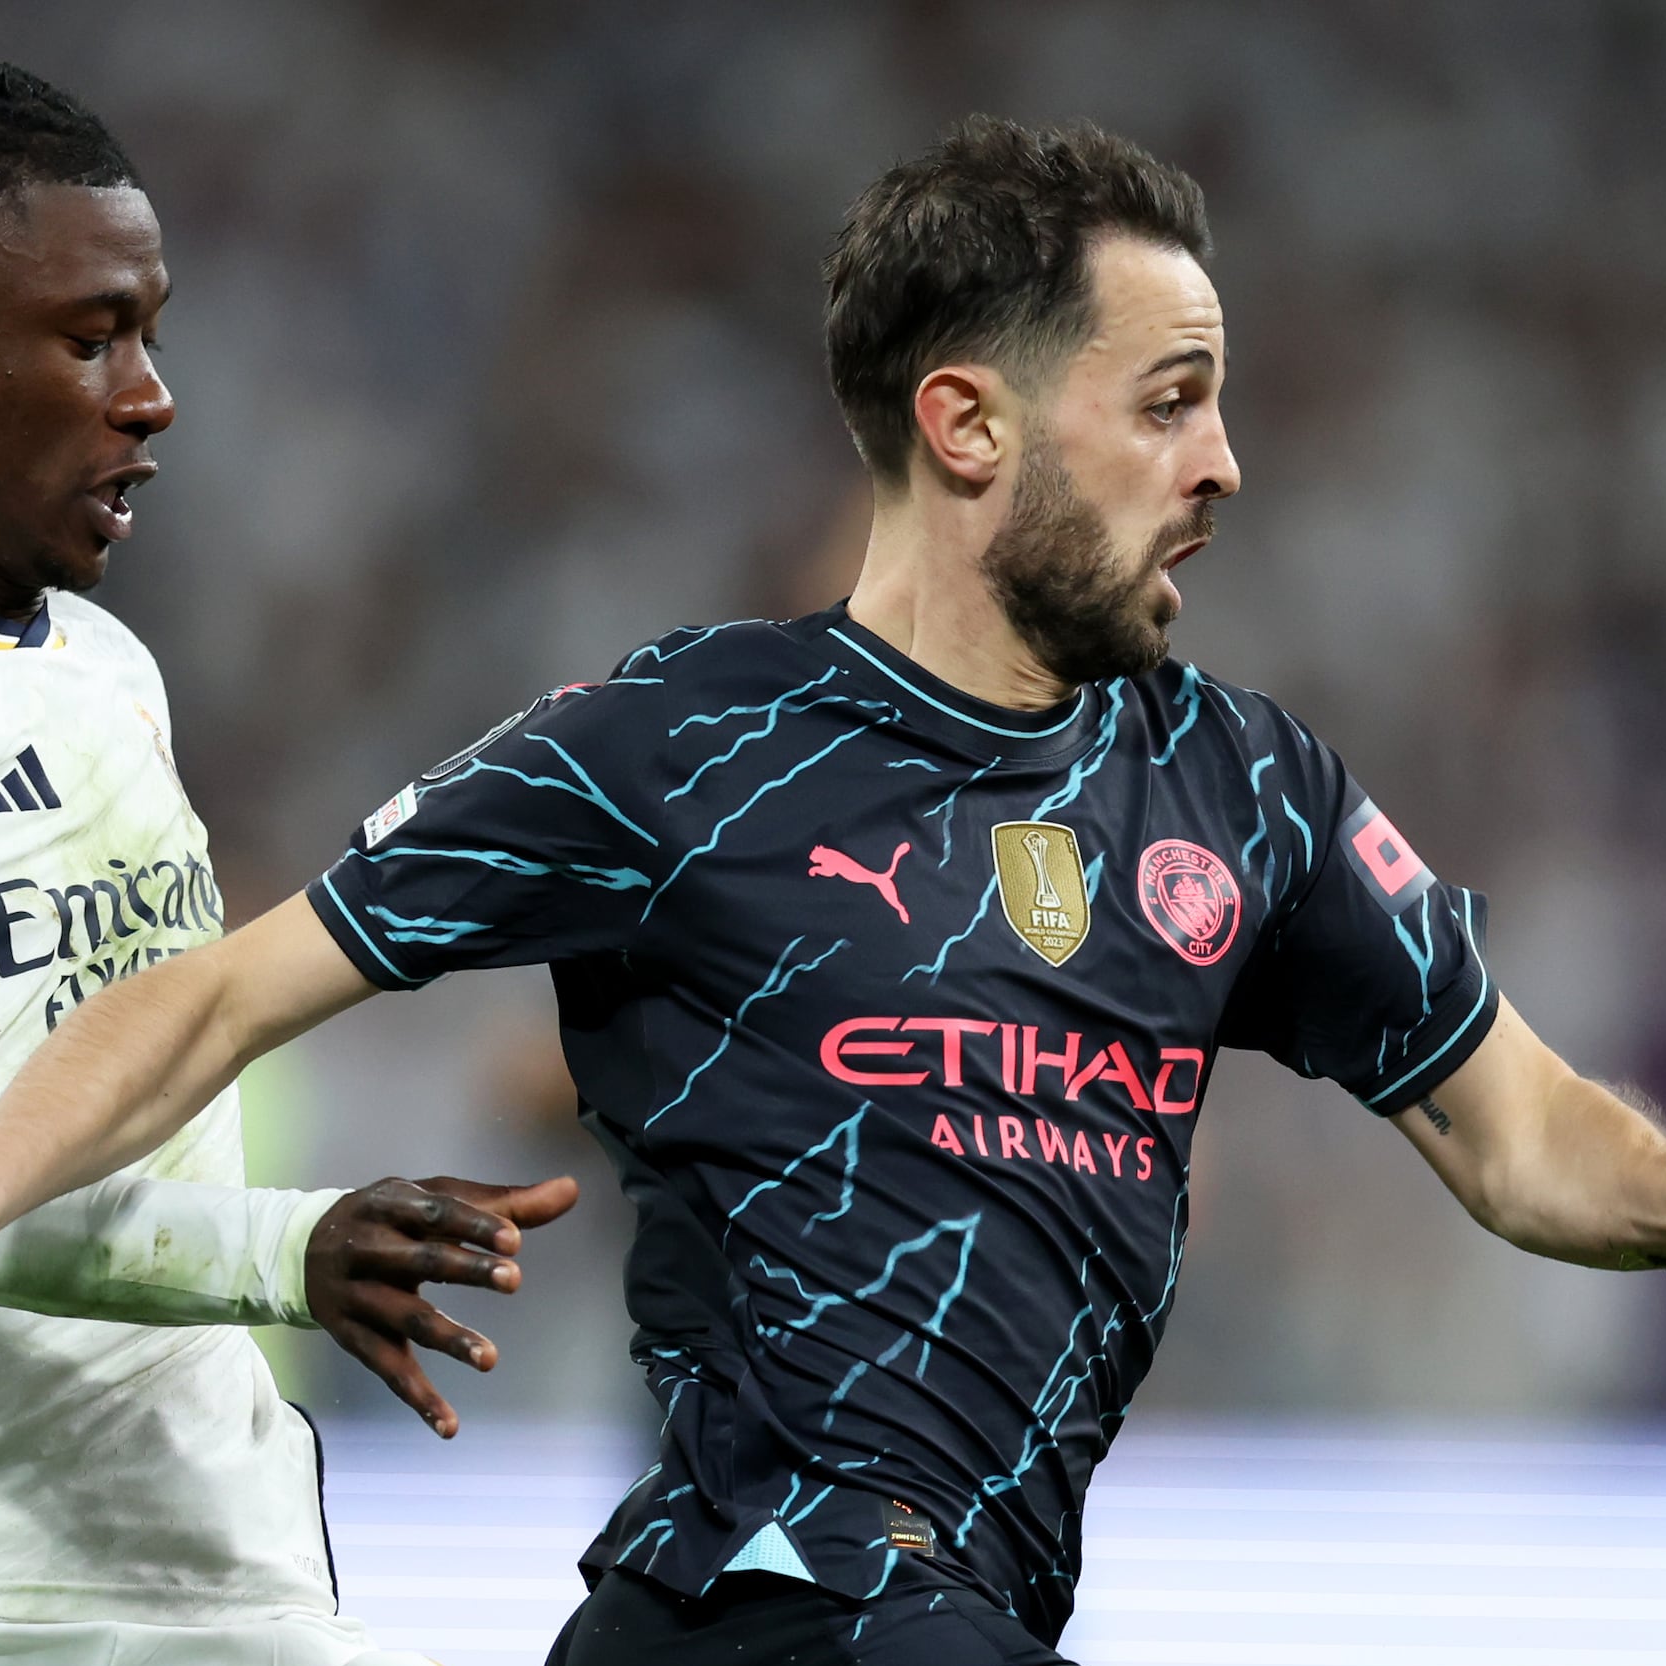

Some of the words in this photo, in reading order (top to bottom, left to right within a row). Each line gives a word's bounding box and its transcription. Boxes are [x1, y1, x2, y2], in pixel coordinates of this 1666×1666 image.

[1145, 848, 1227, 887] MANCHESTER
[1031, 909, 1071, 929] FIFA
[1188, 941, 1213, 954] CITY
[819, 1016, 1205, 1115] ETIHAD
[931, 1113, 1156, 1181] AIRWAYS
